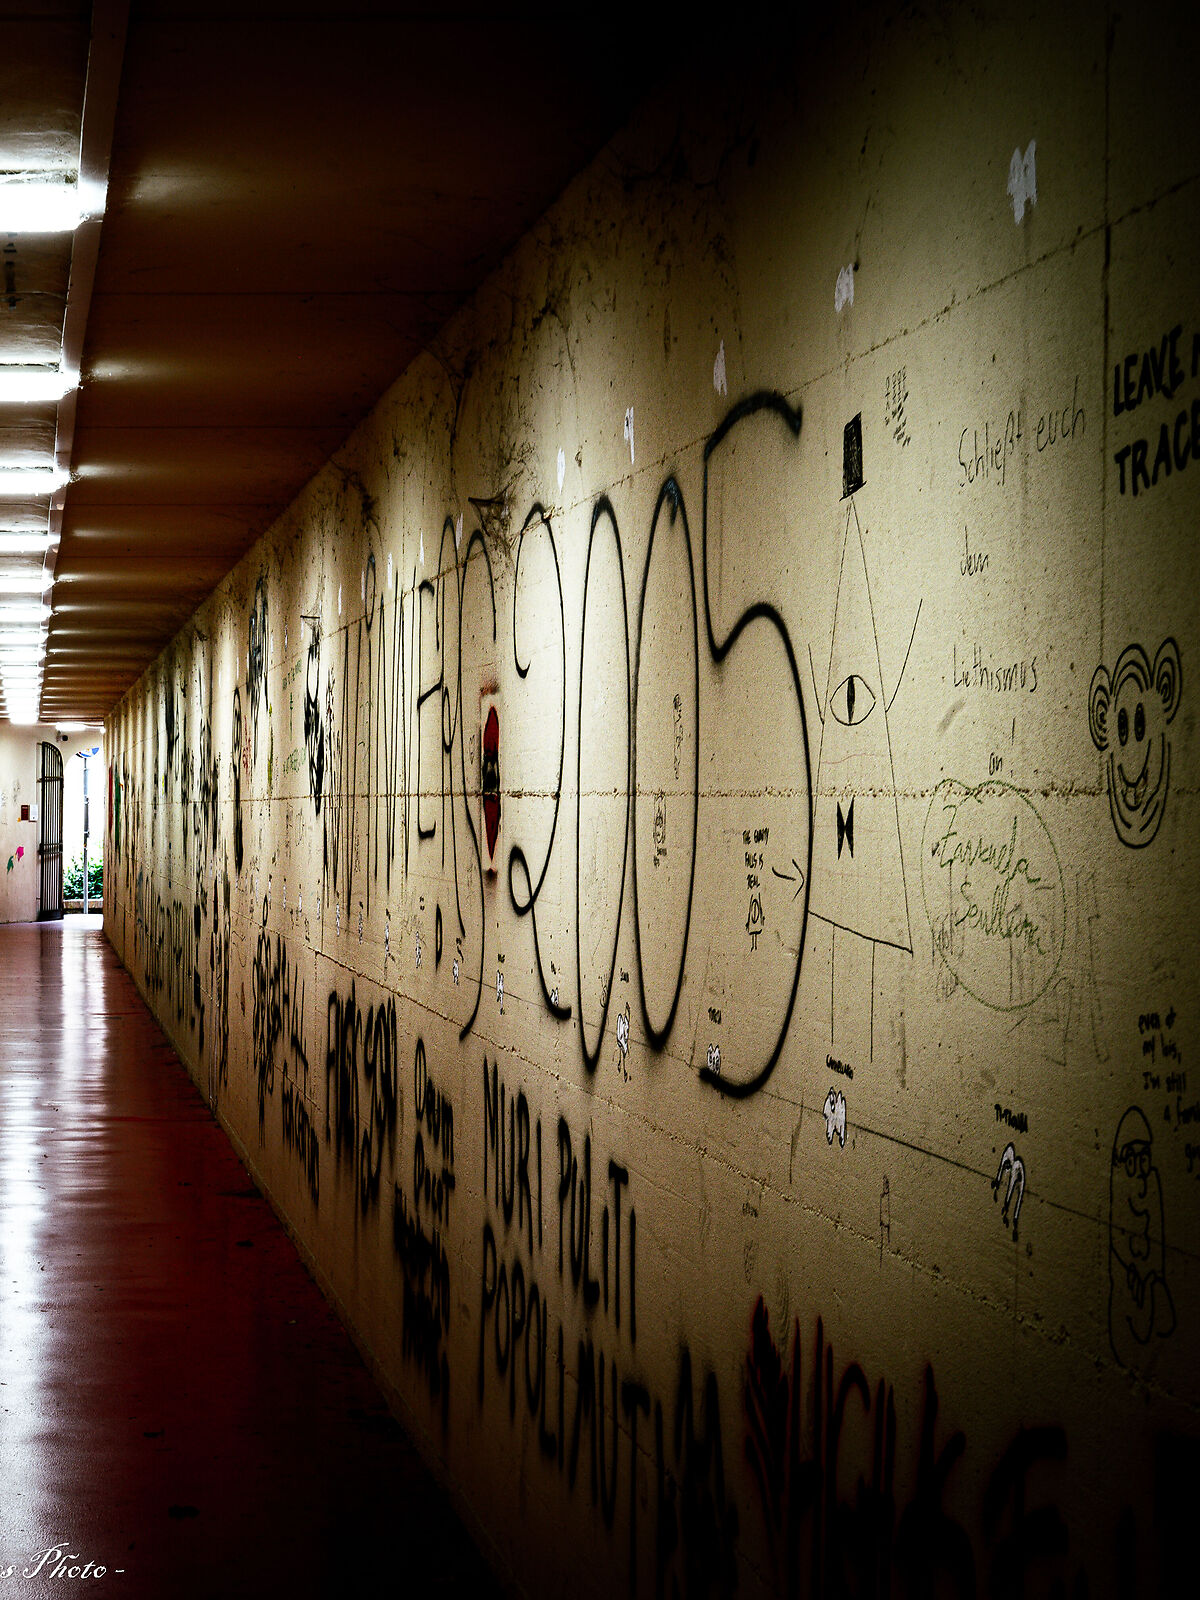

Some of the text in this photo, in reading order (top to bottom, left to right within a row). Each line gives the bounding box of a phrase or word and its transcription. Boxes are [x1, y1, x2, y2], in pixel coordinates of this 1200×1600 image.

[1113, 325, 1184, 417] LEAVE
[483, 1054, 543, 1255] MURI
[478, 1220, 564, 1473] POPOLI
